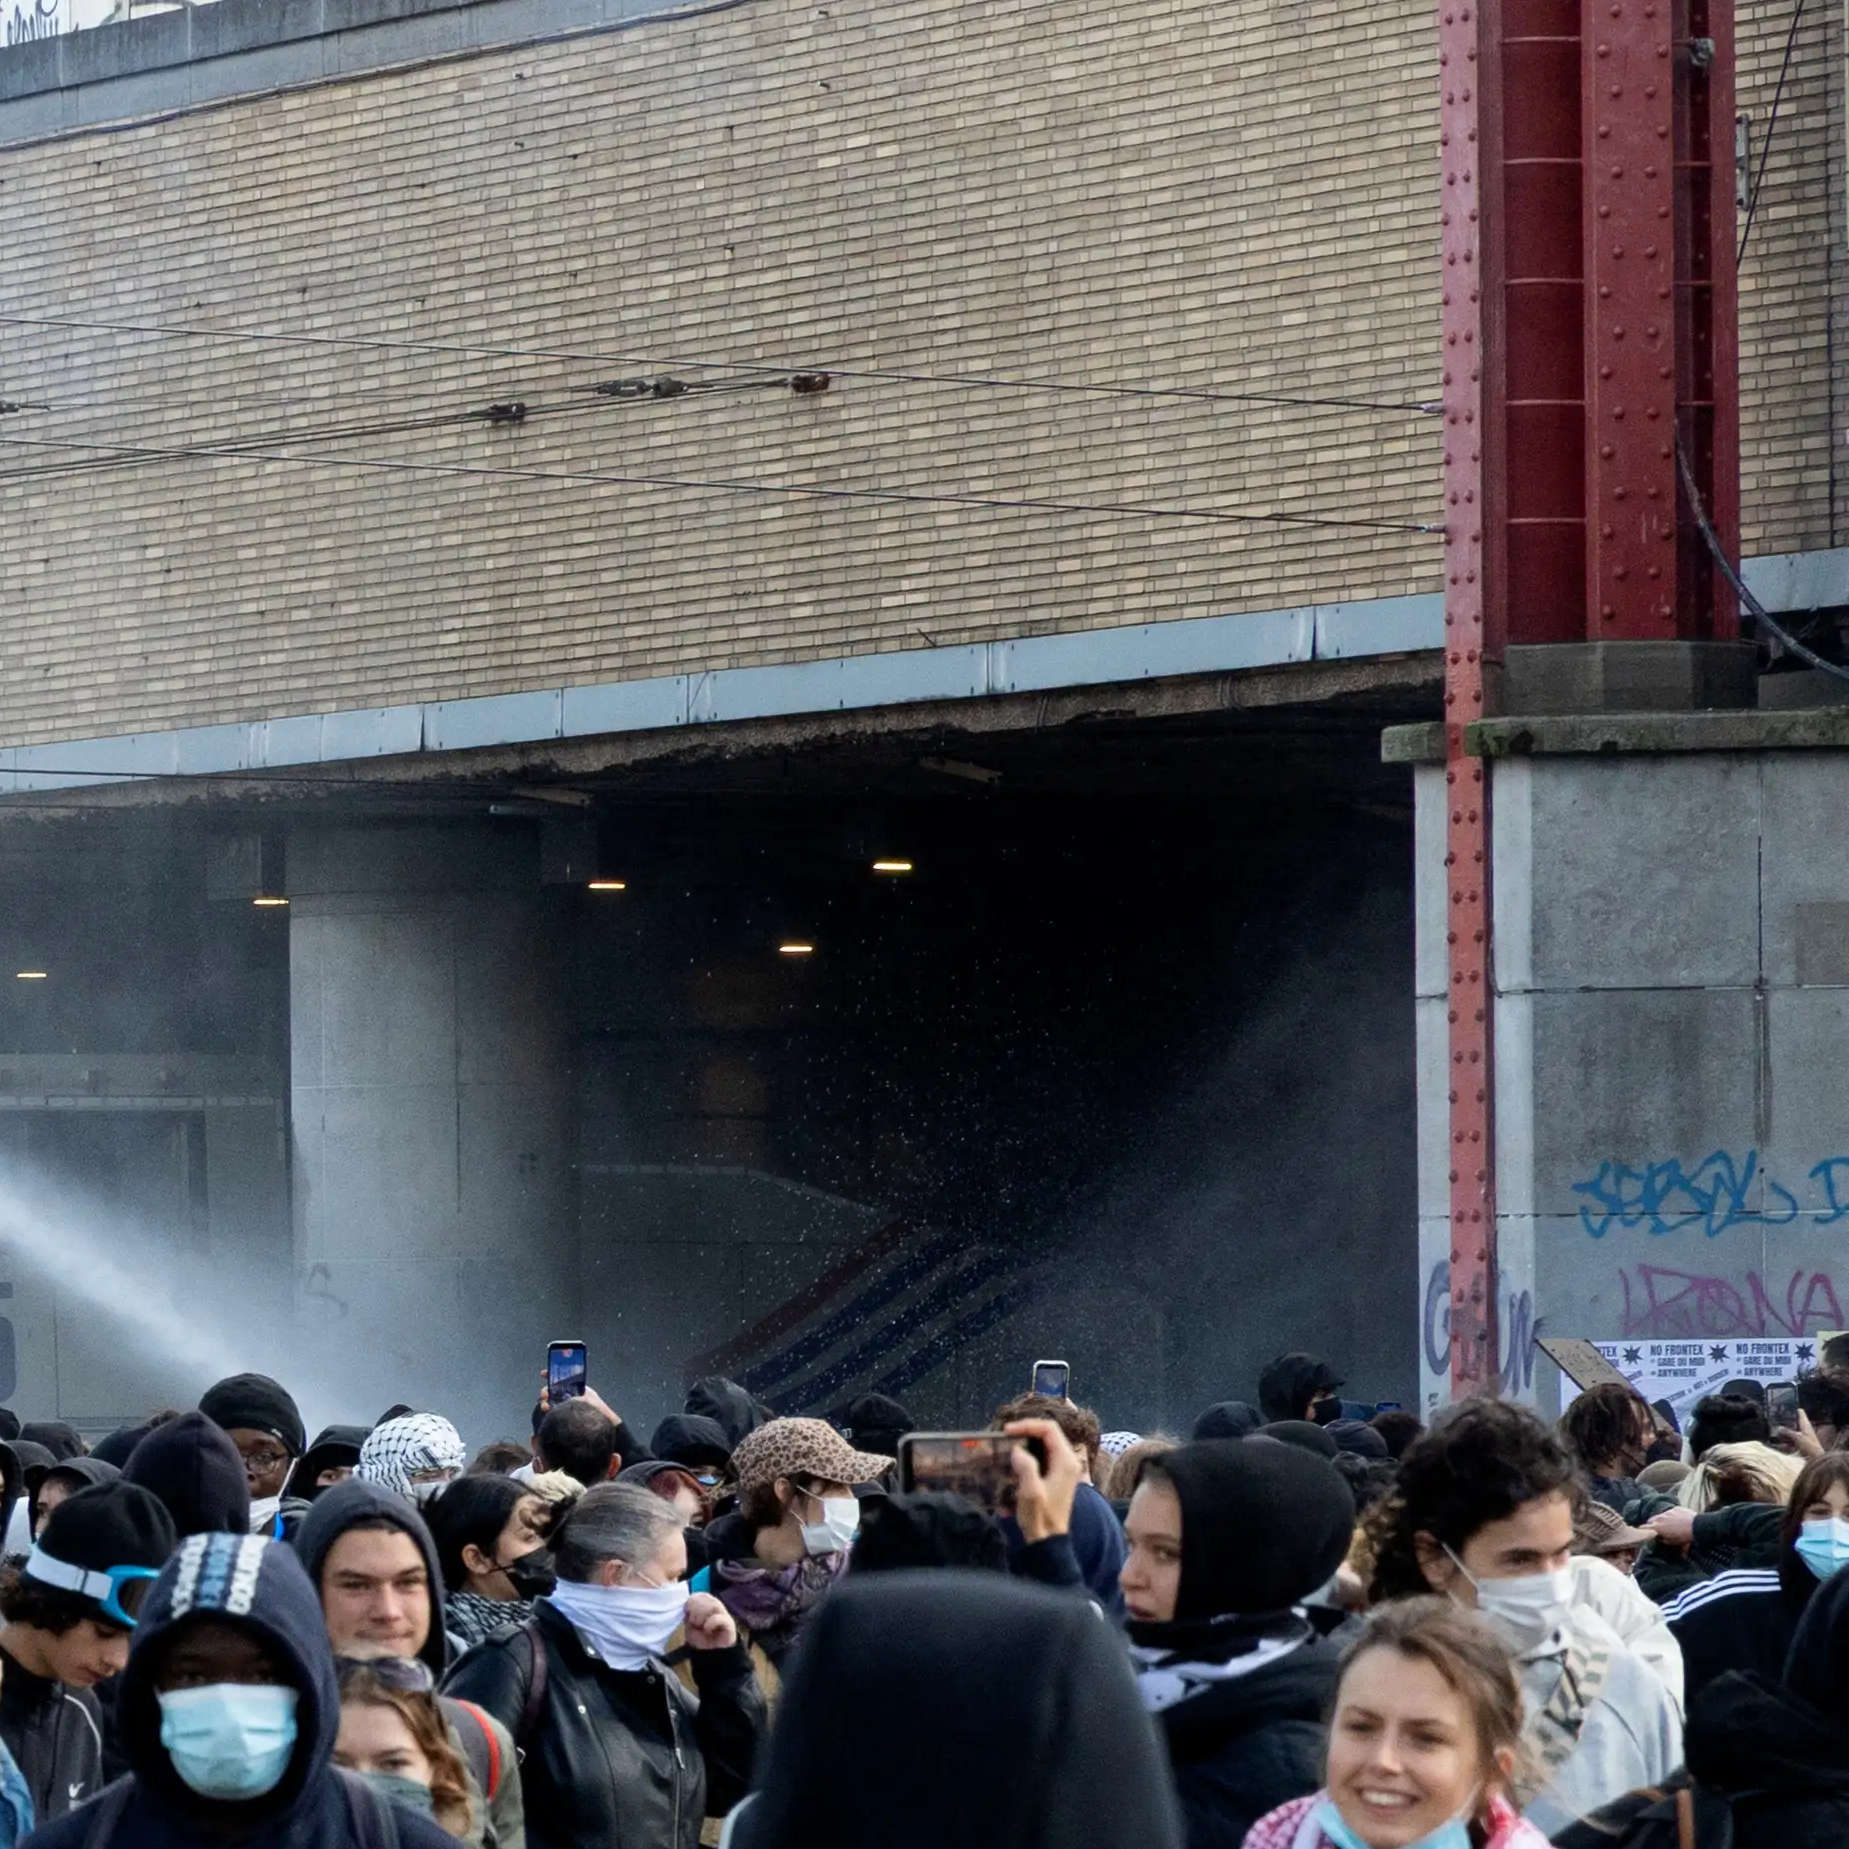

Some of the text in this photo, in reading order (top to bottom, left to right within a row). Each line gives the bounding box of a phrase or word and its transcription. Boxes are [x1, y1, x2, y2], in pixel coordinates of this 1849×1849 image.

[1650, 1343, 1704, 1356] NO FRONTEX
[1736, 1342, 1790, 1354] NO FRONTEX
[1657, 1367, 1698, 1377] ANYWHERE
[1744, 1366, 1784, 1376] ANYWHERE
